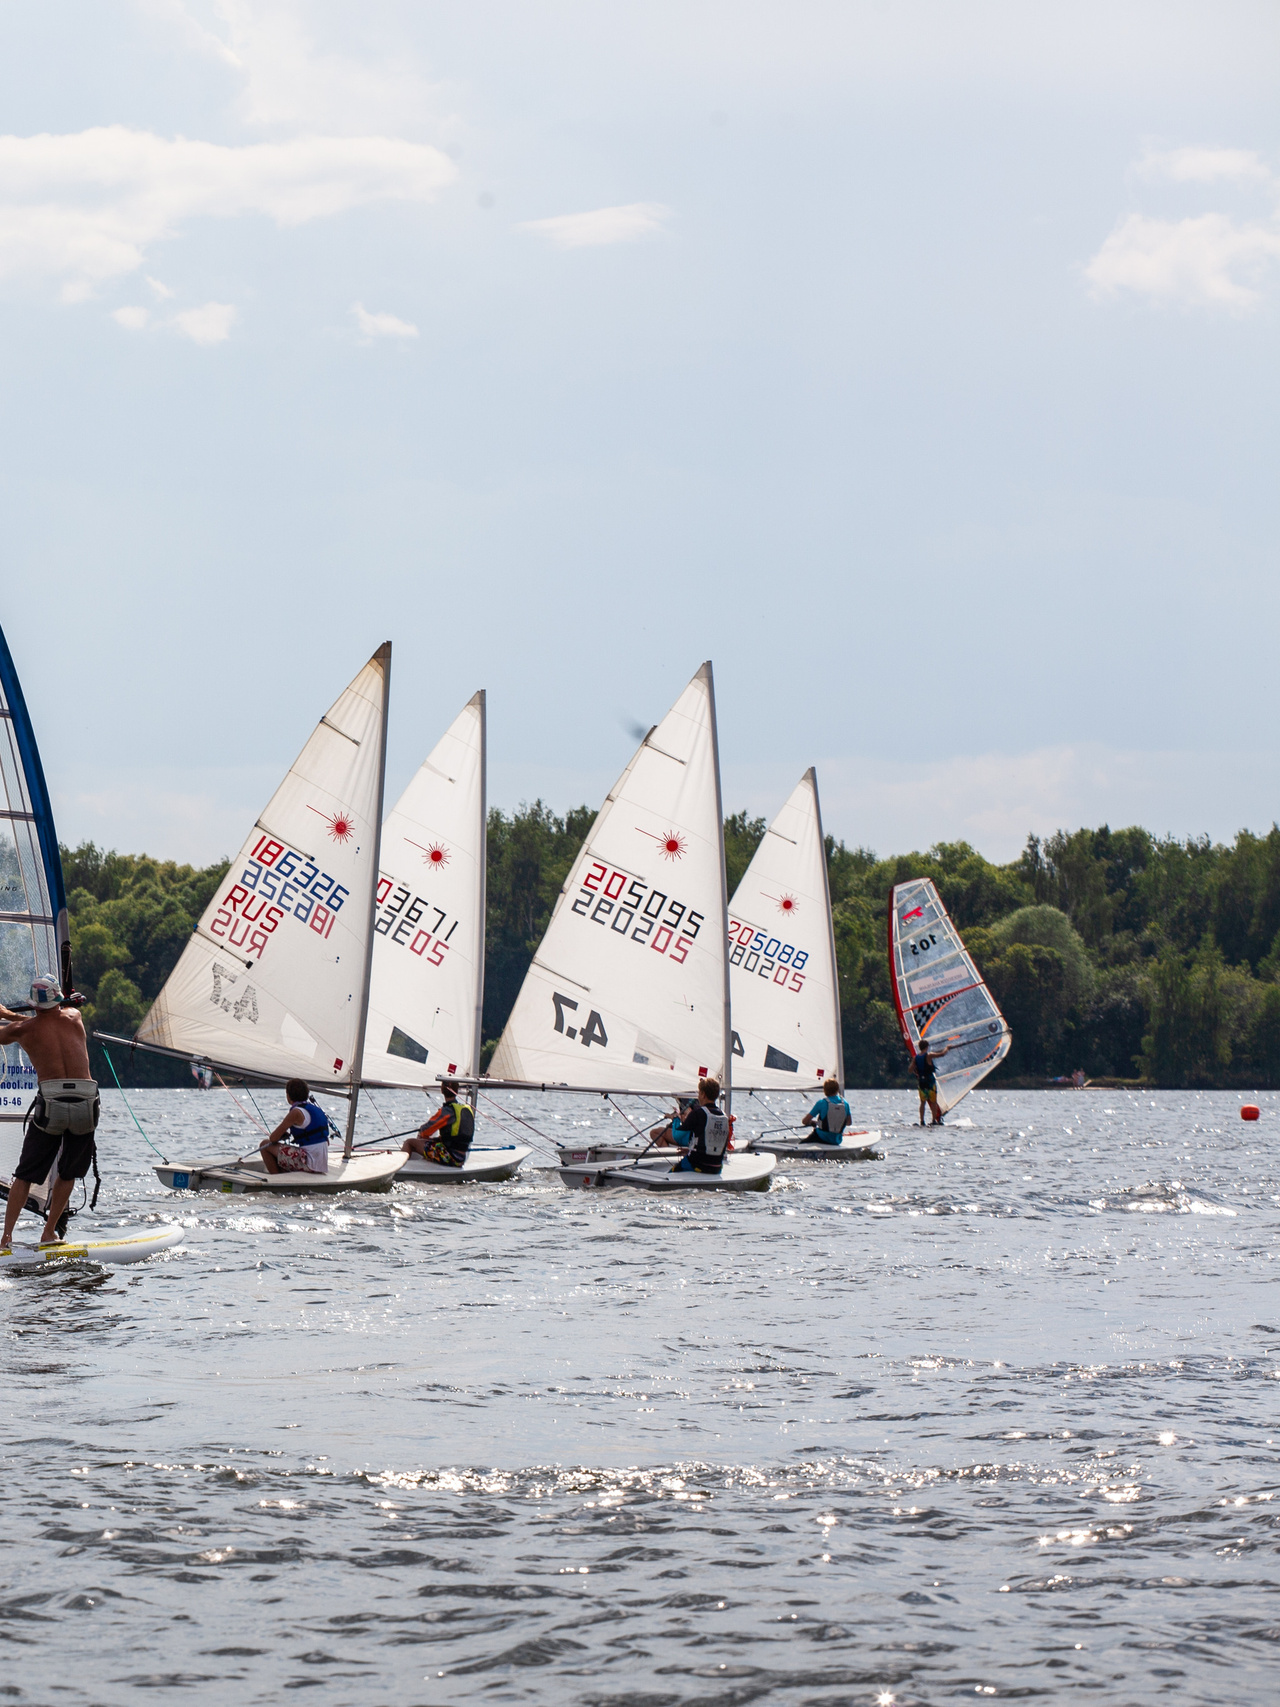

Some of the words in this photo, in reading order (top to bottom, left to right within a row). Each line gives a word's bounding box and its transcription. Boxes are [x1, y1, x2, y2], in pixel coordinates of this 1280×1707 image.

[251, 835, 350, 912] 186326
[583, 862, 705, 939] 205095
[222, 884, 284, 934] RUS
[727, 920, 809, 970] 205088
